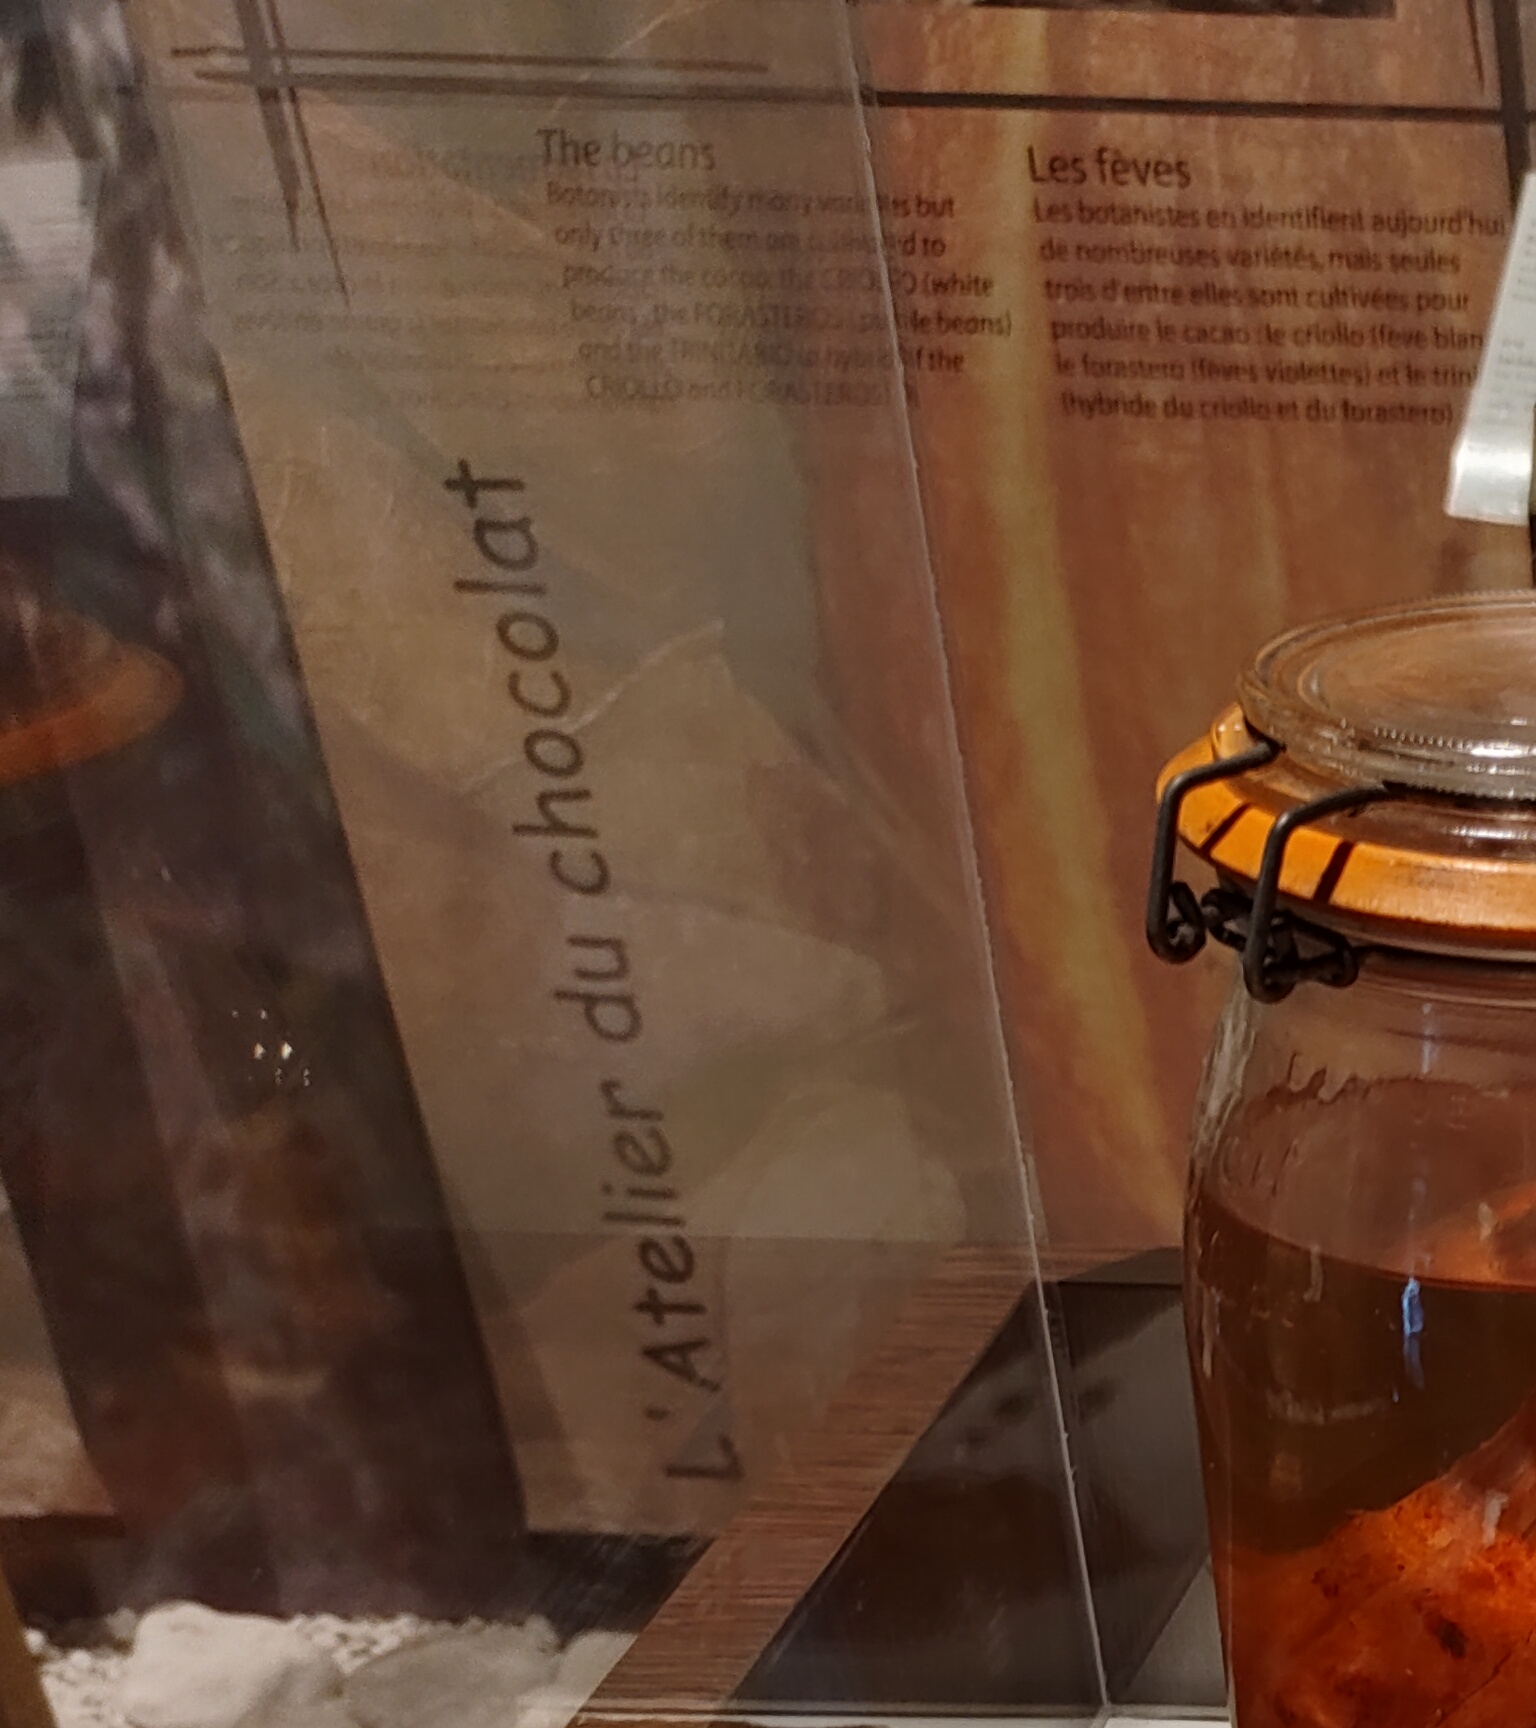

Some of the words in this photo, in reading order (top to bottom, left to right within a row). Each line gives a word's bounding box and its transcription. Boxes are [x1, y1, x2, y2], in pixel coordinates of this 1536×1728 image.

[537, 128, 601, 168] The
[611, 133, 716, 172] beans
[1026, 144, 1087, 184] Les
[1094, 144, 1192, 190] fèves
[916, 191, 955, 218] but
[1033, 196, 1073, 224] Les
[1077, 198, 1200, 229] botanistes
[1206, 208, 1237, 230] en
[1243, 203, 1365, 234] identifient
[554, 224, 601, 253] only
[921, 235, 948, 259] to
[1040, 236, 1069, 263] de
[1075, 239, 1220, 269] nombreuses
[1045, 277, 1097, 303] trois
[1189, 279, 1246, 306] elles
[1248, 284, 1298, 309] sont
[1416, 289, 1470, 316] pour
[1050, 316, 1151, 349] produire
[1155, 318, 1178, 345] le
[1182, 322, 1251, 346] cacao
[927, 348, 967, 375] the
[1055, 353, 1075, 378] le
[1377, 363, 1400, 386] et
[1406, 360, 1428, 386] le
[1163, 393, 1193, 419] du
[1305, 396, 1335, 422] du
[445, 456, 609, 897] chocolat
[555, 934, 642, 1045] du
[604, 1082, 741, 1485] L'Atelier
